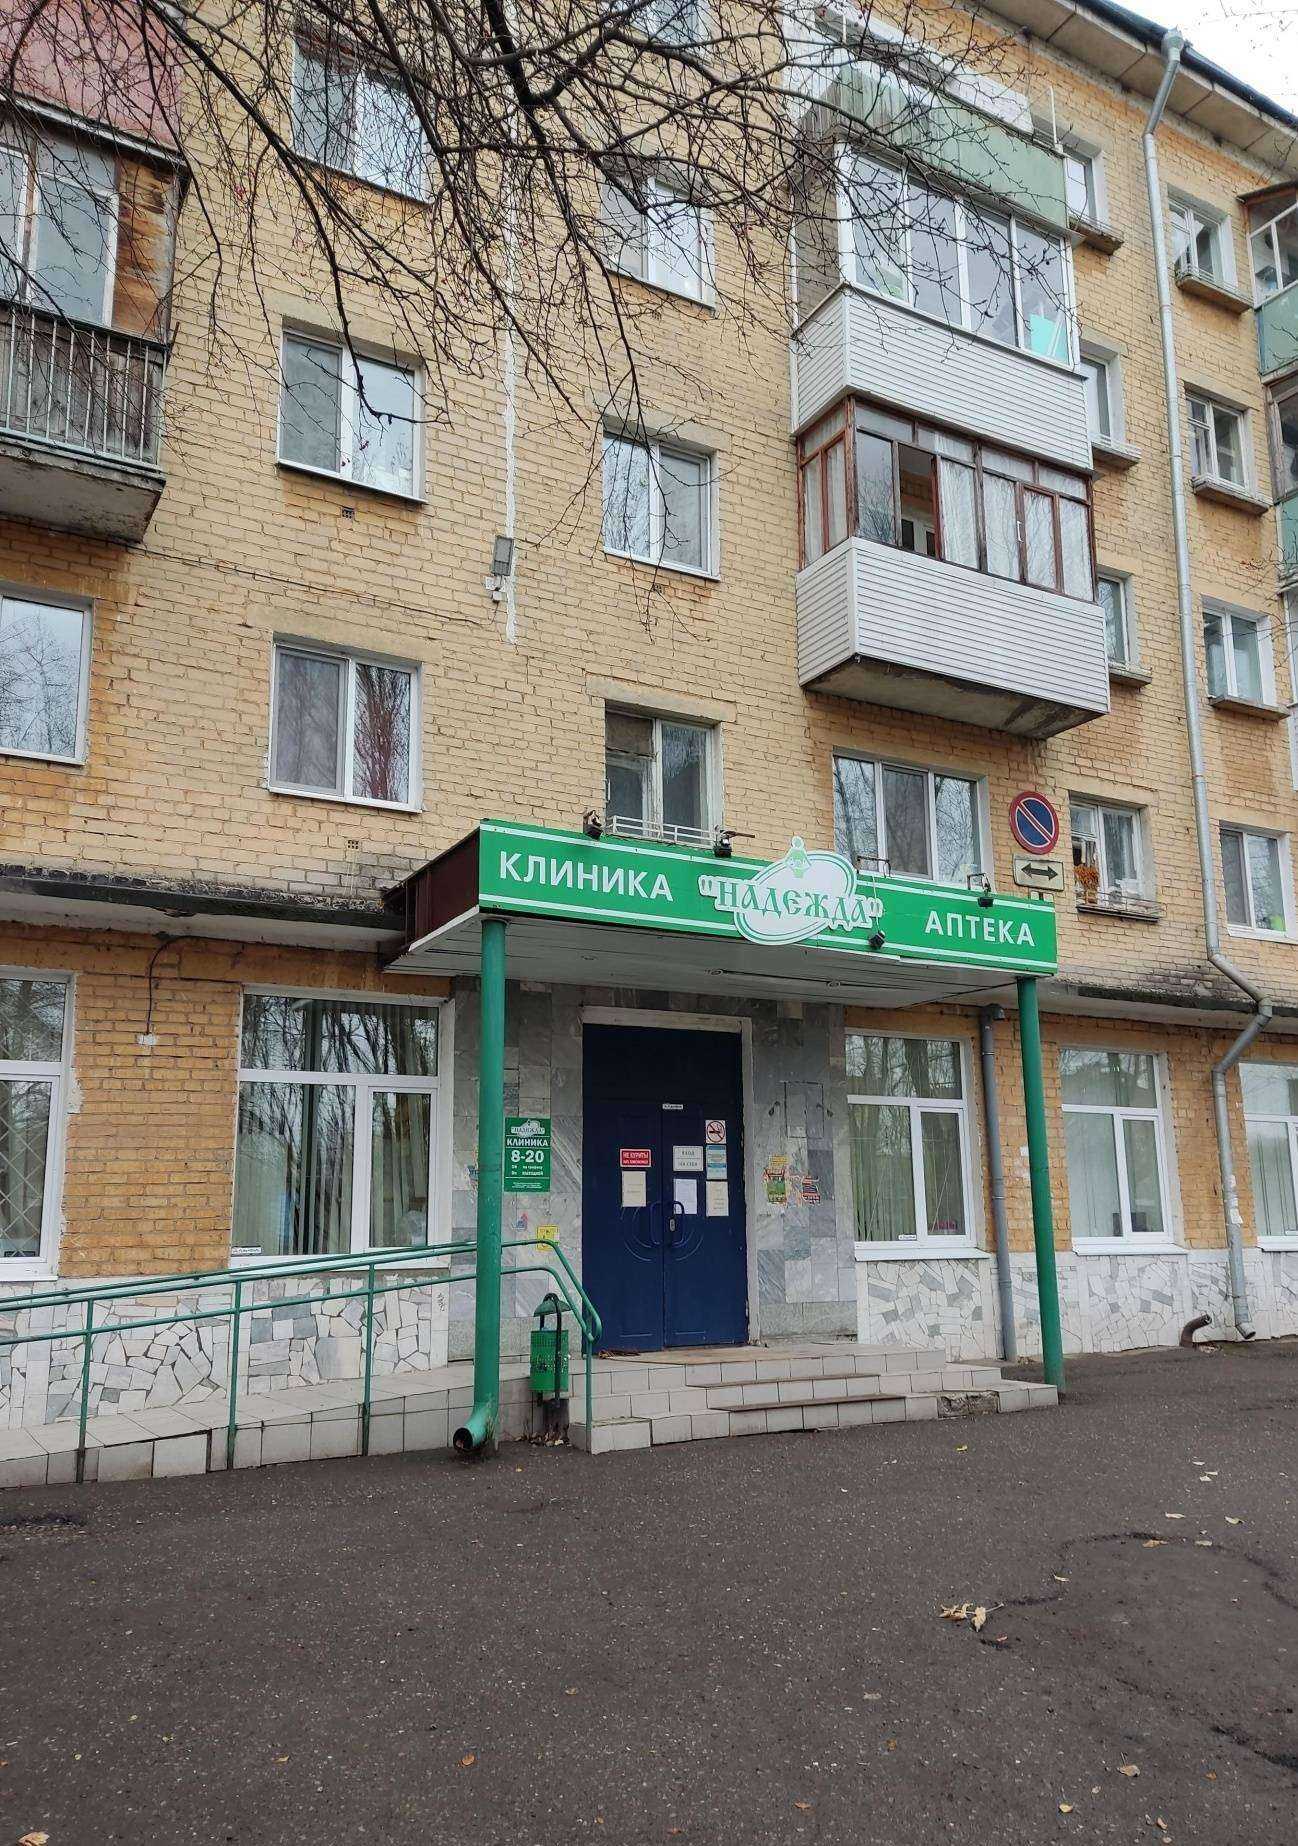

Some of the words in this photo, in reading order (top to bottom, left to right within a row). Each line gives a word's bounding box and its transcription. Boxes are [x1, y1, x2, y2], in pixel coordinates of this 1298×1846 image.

[499, 850, 674, 902] КЛИНИКА
[924, 910, 1036, 947] АПТЕКА
[506, 1138, 549, 1147] КЛИНИКА
[510, 1149, 545, 1163] 8-20
